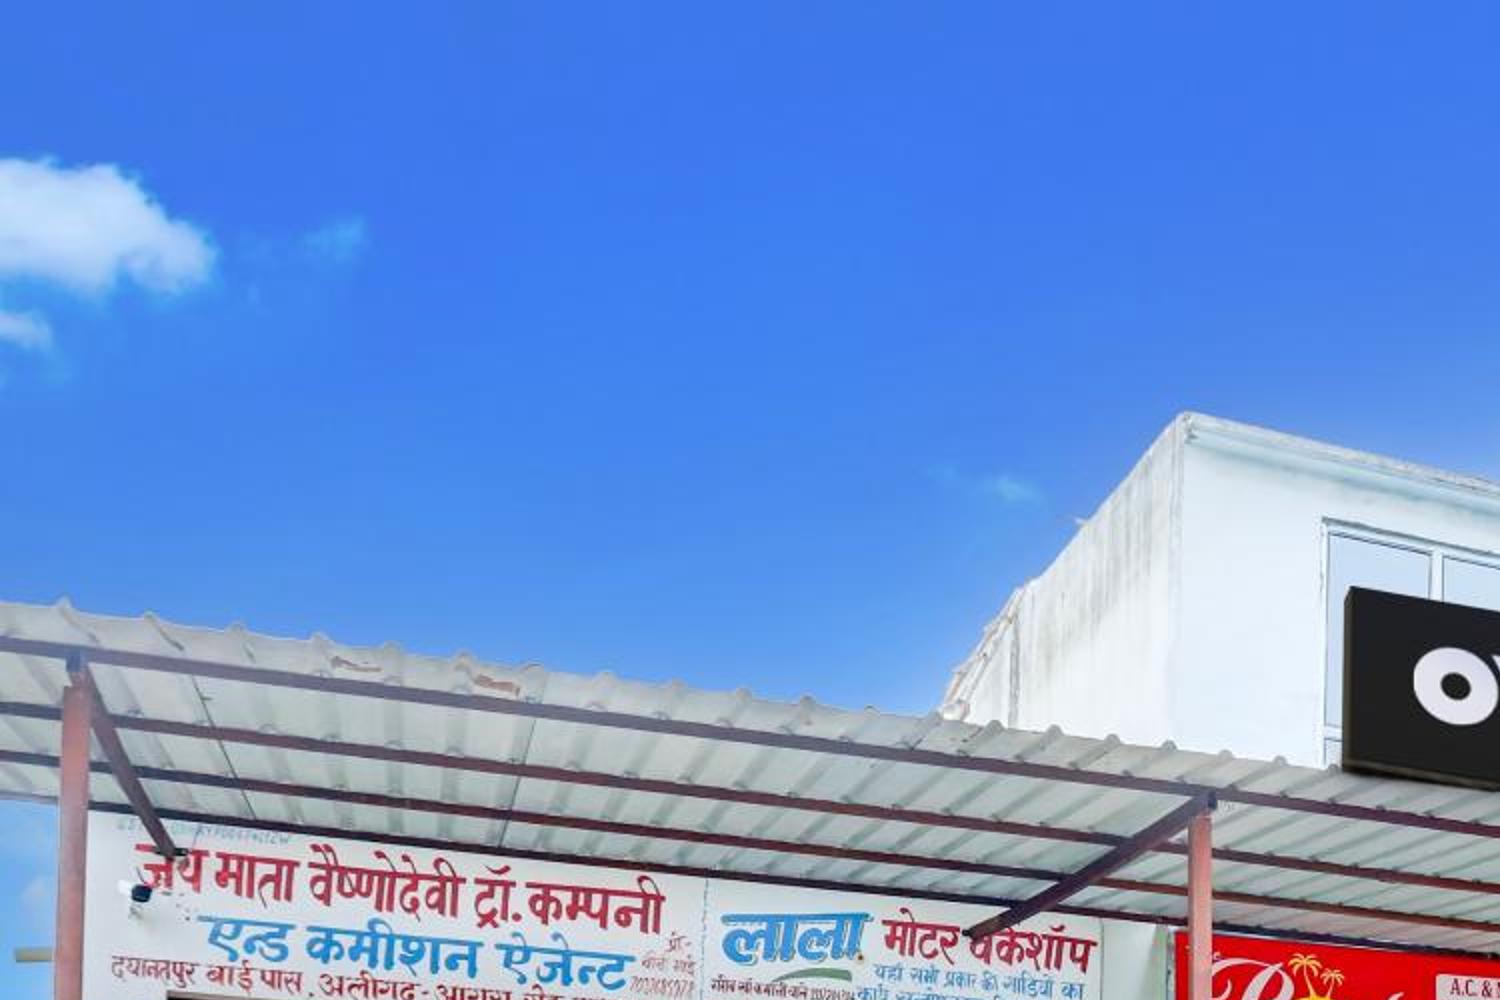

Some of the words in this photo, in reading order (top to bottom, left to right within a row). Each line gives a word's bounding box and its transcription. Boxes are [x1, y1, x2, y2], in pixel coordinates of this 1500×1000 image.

[214, 850, 300, 907] माता
[308, 842, 466, 924] वैष्णोदेवी
[525, 874, 667, 935] कम्पनी
[197, 914, 296, 963] एन्ड
[305, 913, 484, 980] कमीशन
[494, 931, 636, 991] ऐजेन्ट
[720, 911, 873, 966] लाला
[881, 907, 962, 965] मोटर
[1481, 980, 1494, 998] &
